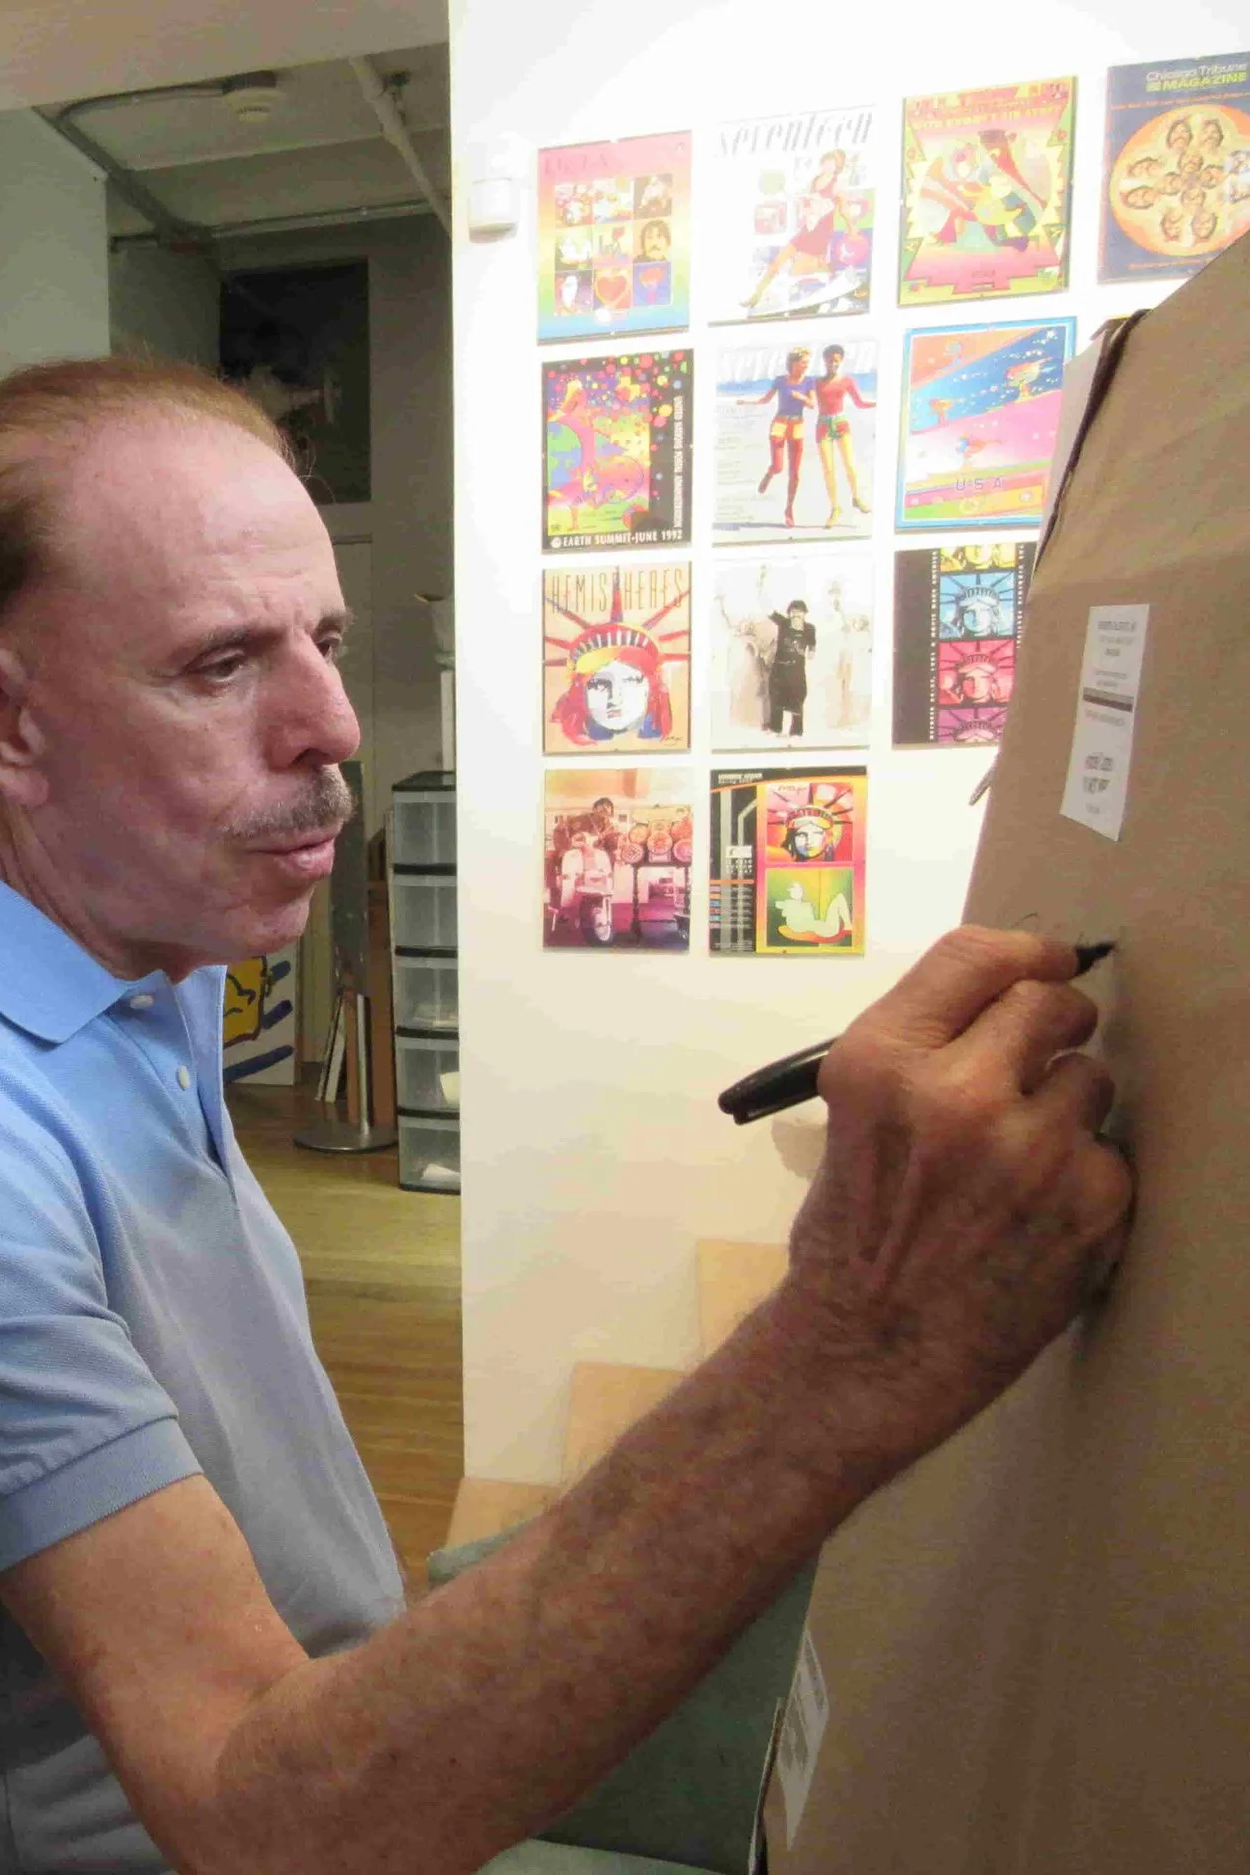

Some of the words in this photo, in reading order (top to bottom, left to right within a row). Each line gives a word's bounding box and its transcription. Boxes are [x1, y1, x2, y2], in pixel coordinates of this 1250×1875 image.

[1159, 72, 1247, 92] MAGAZINE
[562, 535, 592, 548] EARTH
[661, 529, 683, 541] 1992
